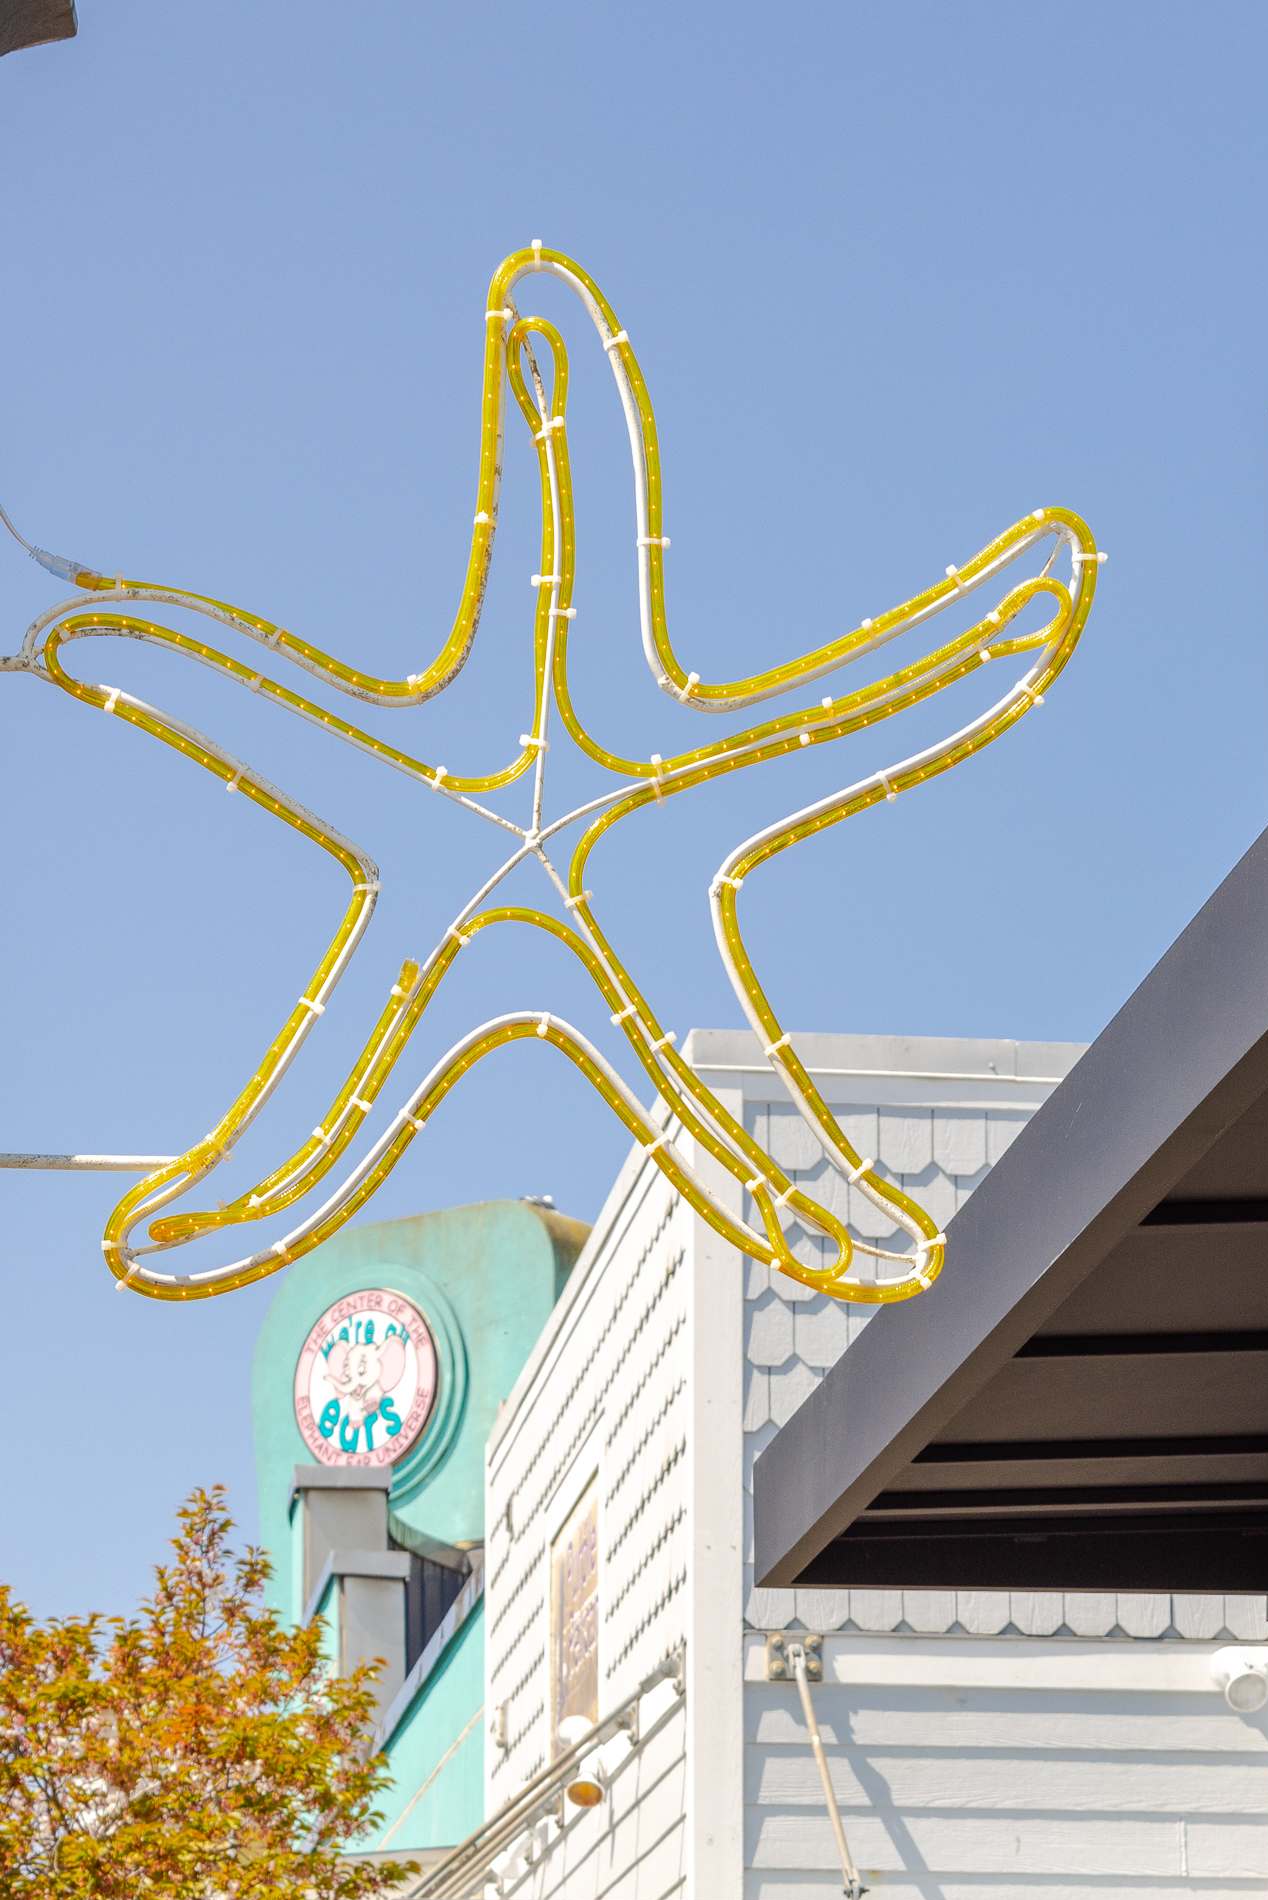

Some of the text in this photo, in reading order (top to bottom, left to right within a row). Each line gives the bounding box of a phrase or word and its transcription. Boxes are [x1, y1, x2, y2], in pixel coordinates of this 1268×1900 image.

[305, 1293, 429, 1355] THE CENTER OF THE
[296, 1395, 343, 1464] ELEPHANT
[375, 1387, 430, 1463] UNIVERSE
